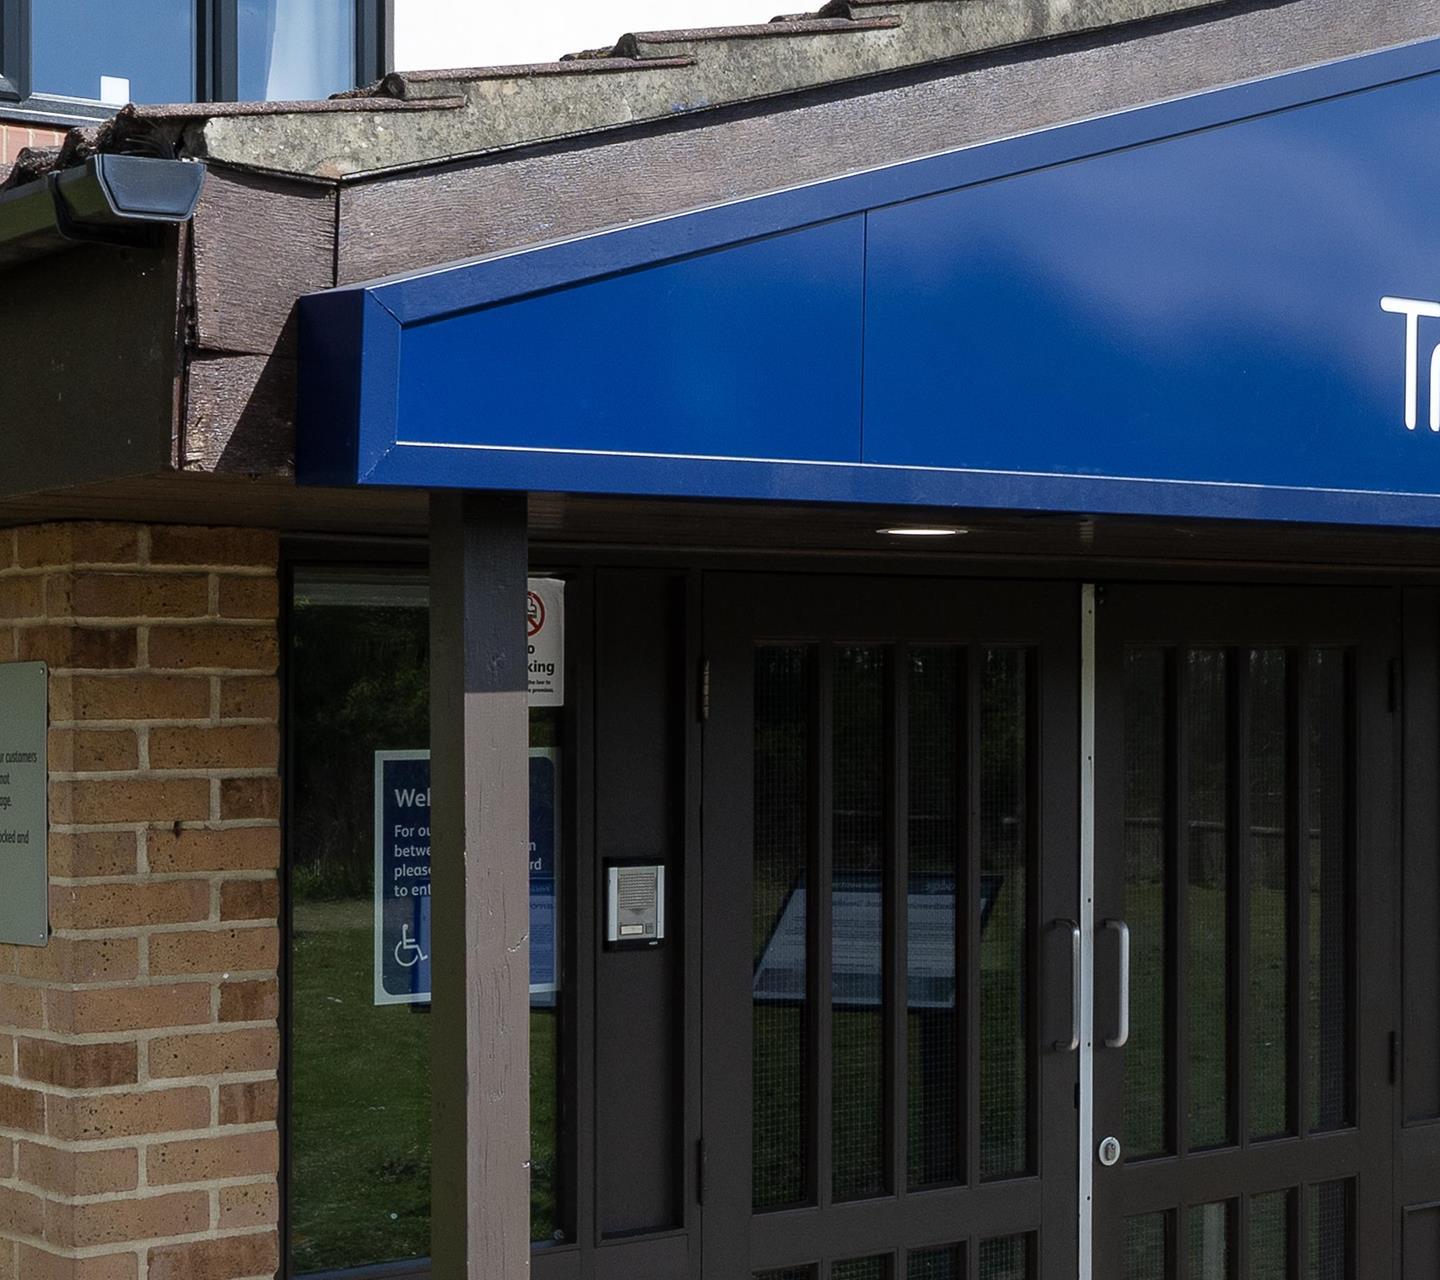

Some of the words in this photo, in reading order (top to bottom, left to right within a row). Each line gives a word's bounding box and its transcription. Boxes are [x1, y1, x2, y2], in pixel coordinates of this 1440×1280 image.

[528, 644, 535, 654] o
[528, 660, 554, 676] king
[6, 751, 37, 763] customers
[394, 788, 431, 808] Wel
[17, 830, 29, 844] and
[394, 825, 414, 838] For
[394, 845, 431, 857] betwe
[394, 885, 408, 897] to
